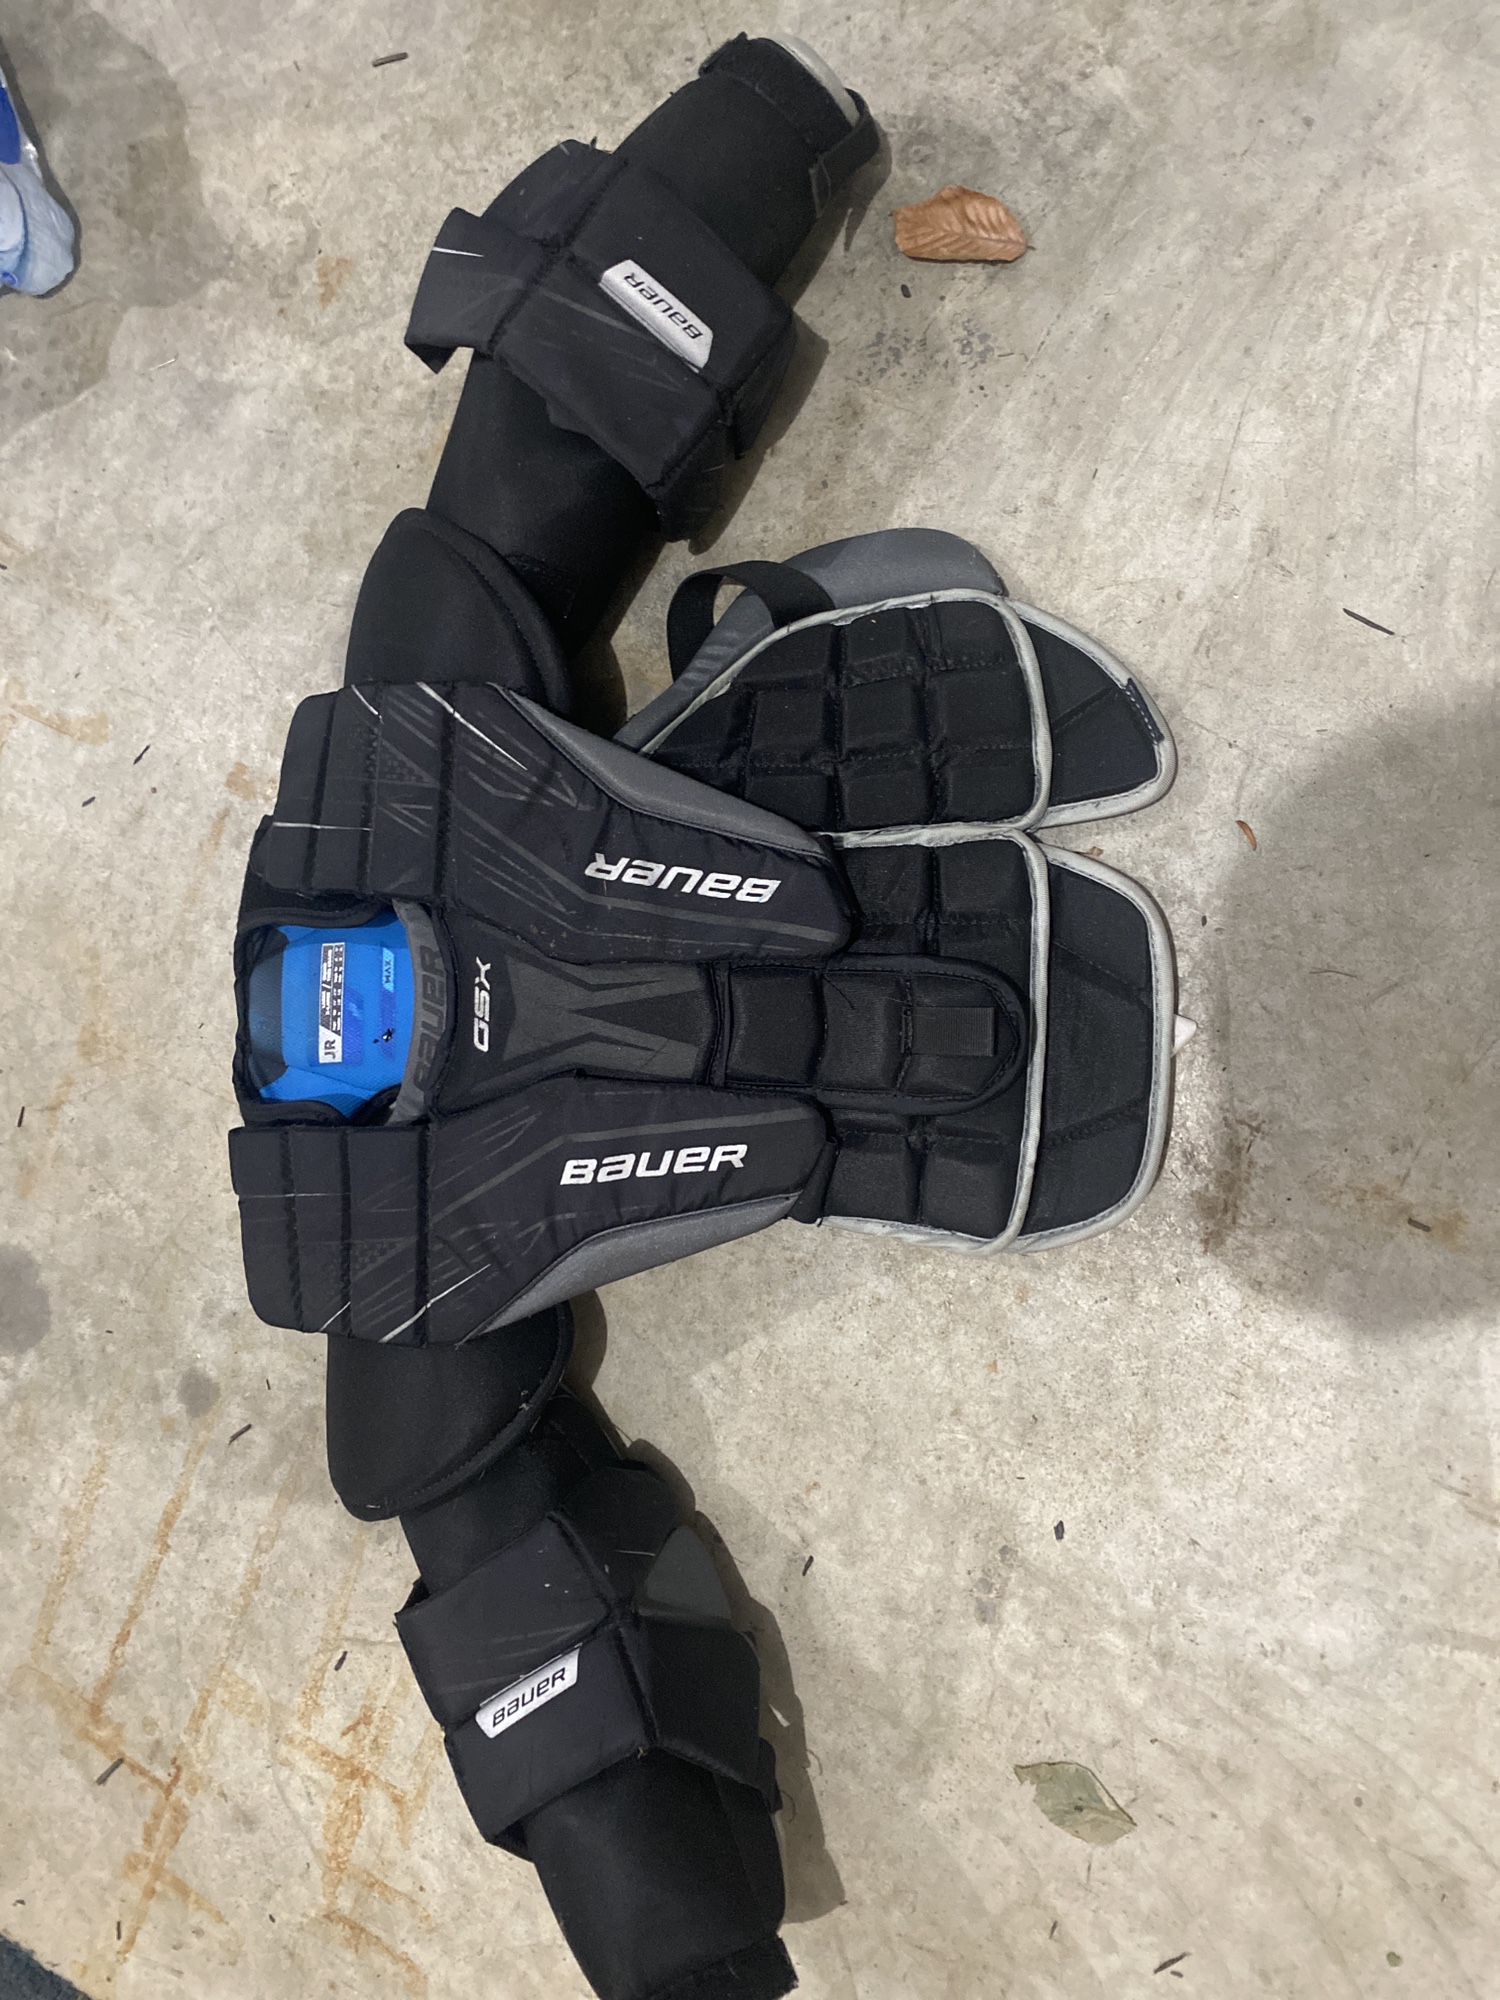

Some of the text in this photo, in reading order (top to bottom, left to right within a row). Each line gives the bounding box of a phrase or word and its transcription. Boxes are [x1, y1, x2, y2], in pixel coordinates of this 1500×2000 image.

[624, 272, 703, 340] BAUER
[584, 852, 782, 904] BAUER
[473, 956, 491, 1053] GSX
[324, 1039, 336, 1060] JR
[560, 1143, 749, 1186] BAUER
[492, 1667, 566, 1728] BAUER
